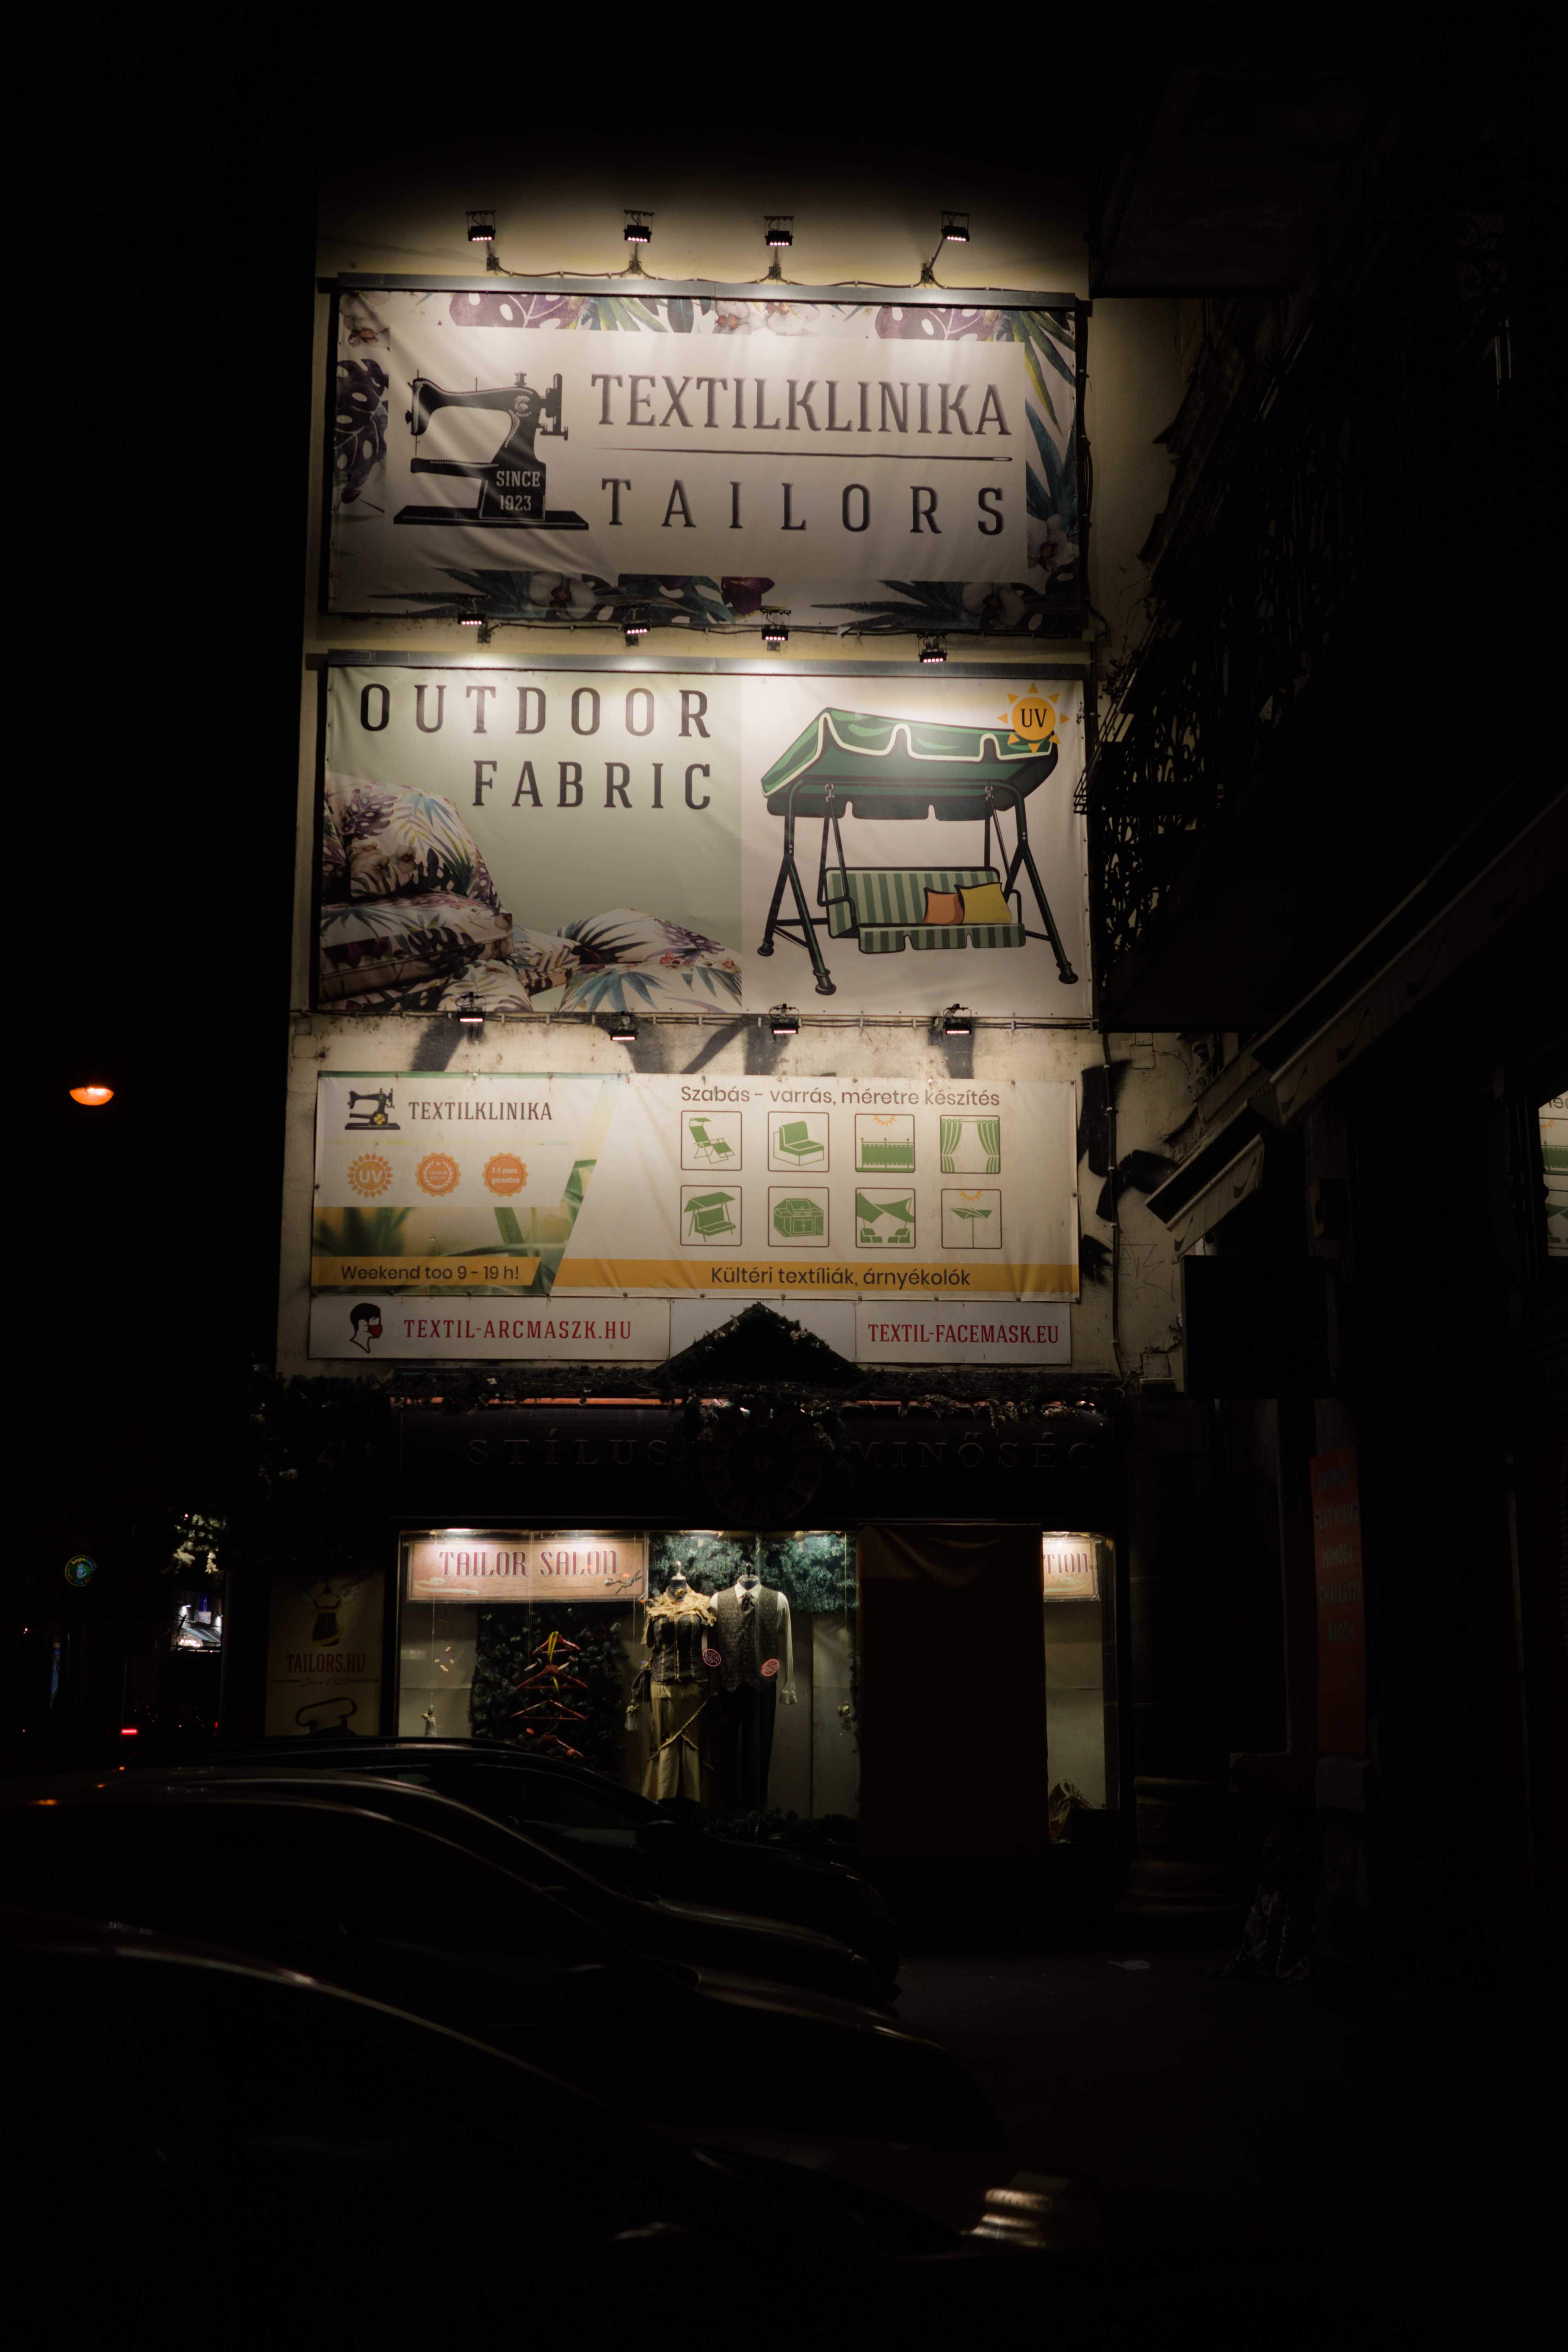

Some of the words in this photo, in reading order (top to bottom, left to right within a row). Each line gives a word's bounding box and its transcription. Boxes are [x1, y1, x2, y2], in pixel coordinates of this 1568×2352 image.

[591, 374, 1012, 436] TEXTILKLINIKA
[496, 470, 540, 487] SINCE
[500, 495, 531, 511] 1923
[602, 479, 1004, 536] TAILORS
[360, 683, 710, 738] OUTDOOR
[1020, 708, 1047, 728] UV
[472, 760, 710, 810] FABRIC
[681, 1085, 750, 1102] Szabás
[769, 1087, 836, 1106] varrás,
[842, 1089, 920, 1105] méretre
[925, 1088, 1000, 1107] készítés
[408, 1102, 552, 1120] TEXTILKLINIKA
[359, 1170, 383, 1183] UV
[341, 1265, 420, 1279] Weekend
[425, 1267, 452, 1279] too
[457, 1266, 466, 1279] 9
[484, 1266, 499, 1279] 19
[504, 1266, 519, 1279] h!
[711, 1267, 773, 1283] Kültéri
[779, 1267, 858, 1287] textíliák,
[862, 1268, 971, 1290] árnyékolók
[404, 1320, 632, 1340] TEXTIL-ARCMASZK.HU
[868, 1323, 1059, 1344] TEXTIL-FACEMASK.EU
[467, 1427, 667, 1465] STÍLUS
[849, 1432, 1095, 1468] MINŐSÉG
[439, 1551, 530, 1577] TAILOR
[539, 1550, 619, 1577] SALON
[286, 1653, 365, 1673] TAILORS.HU
